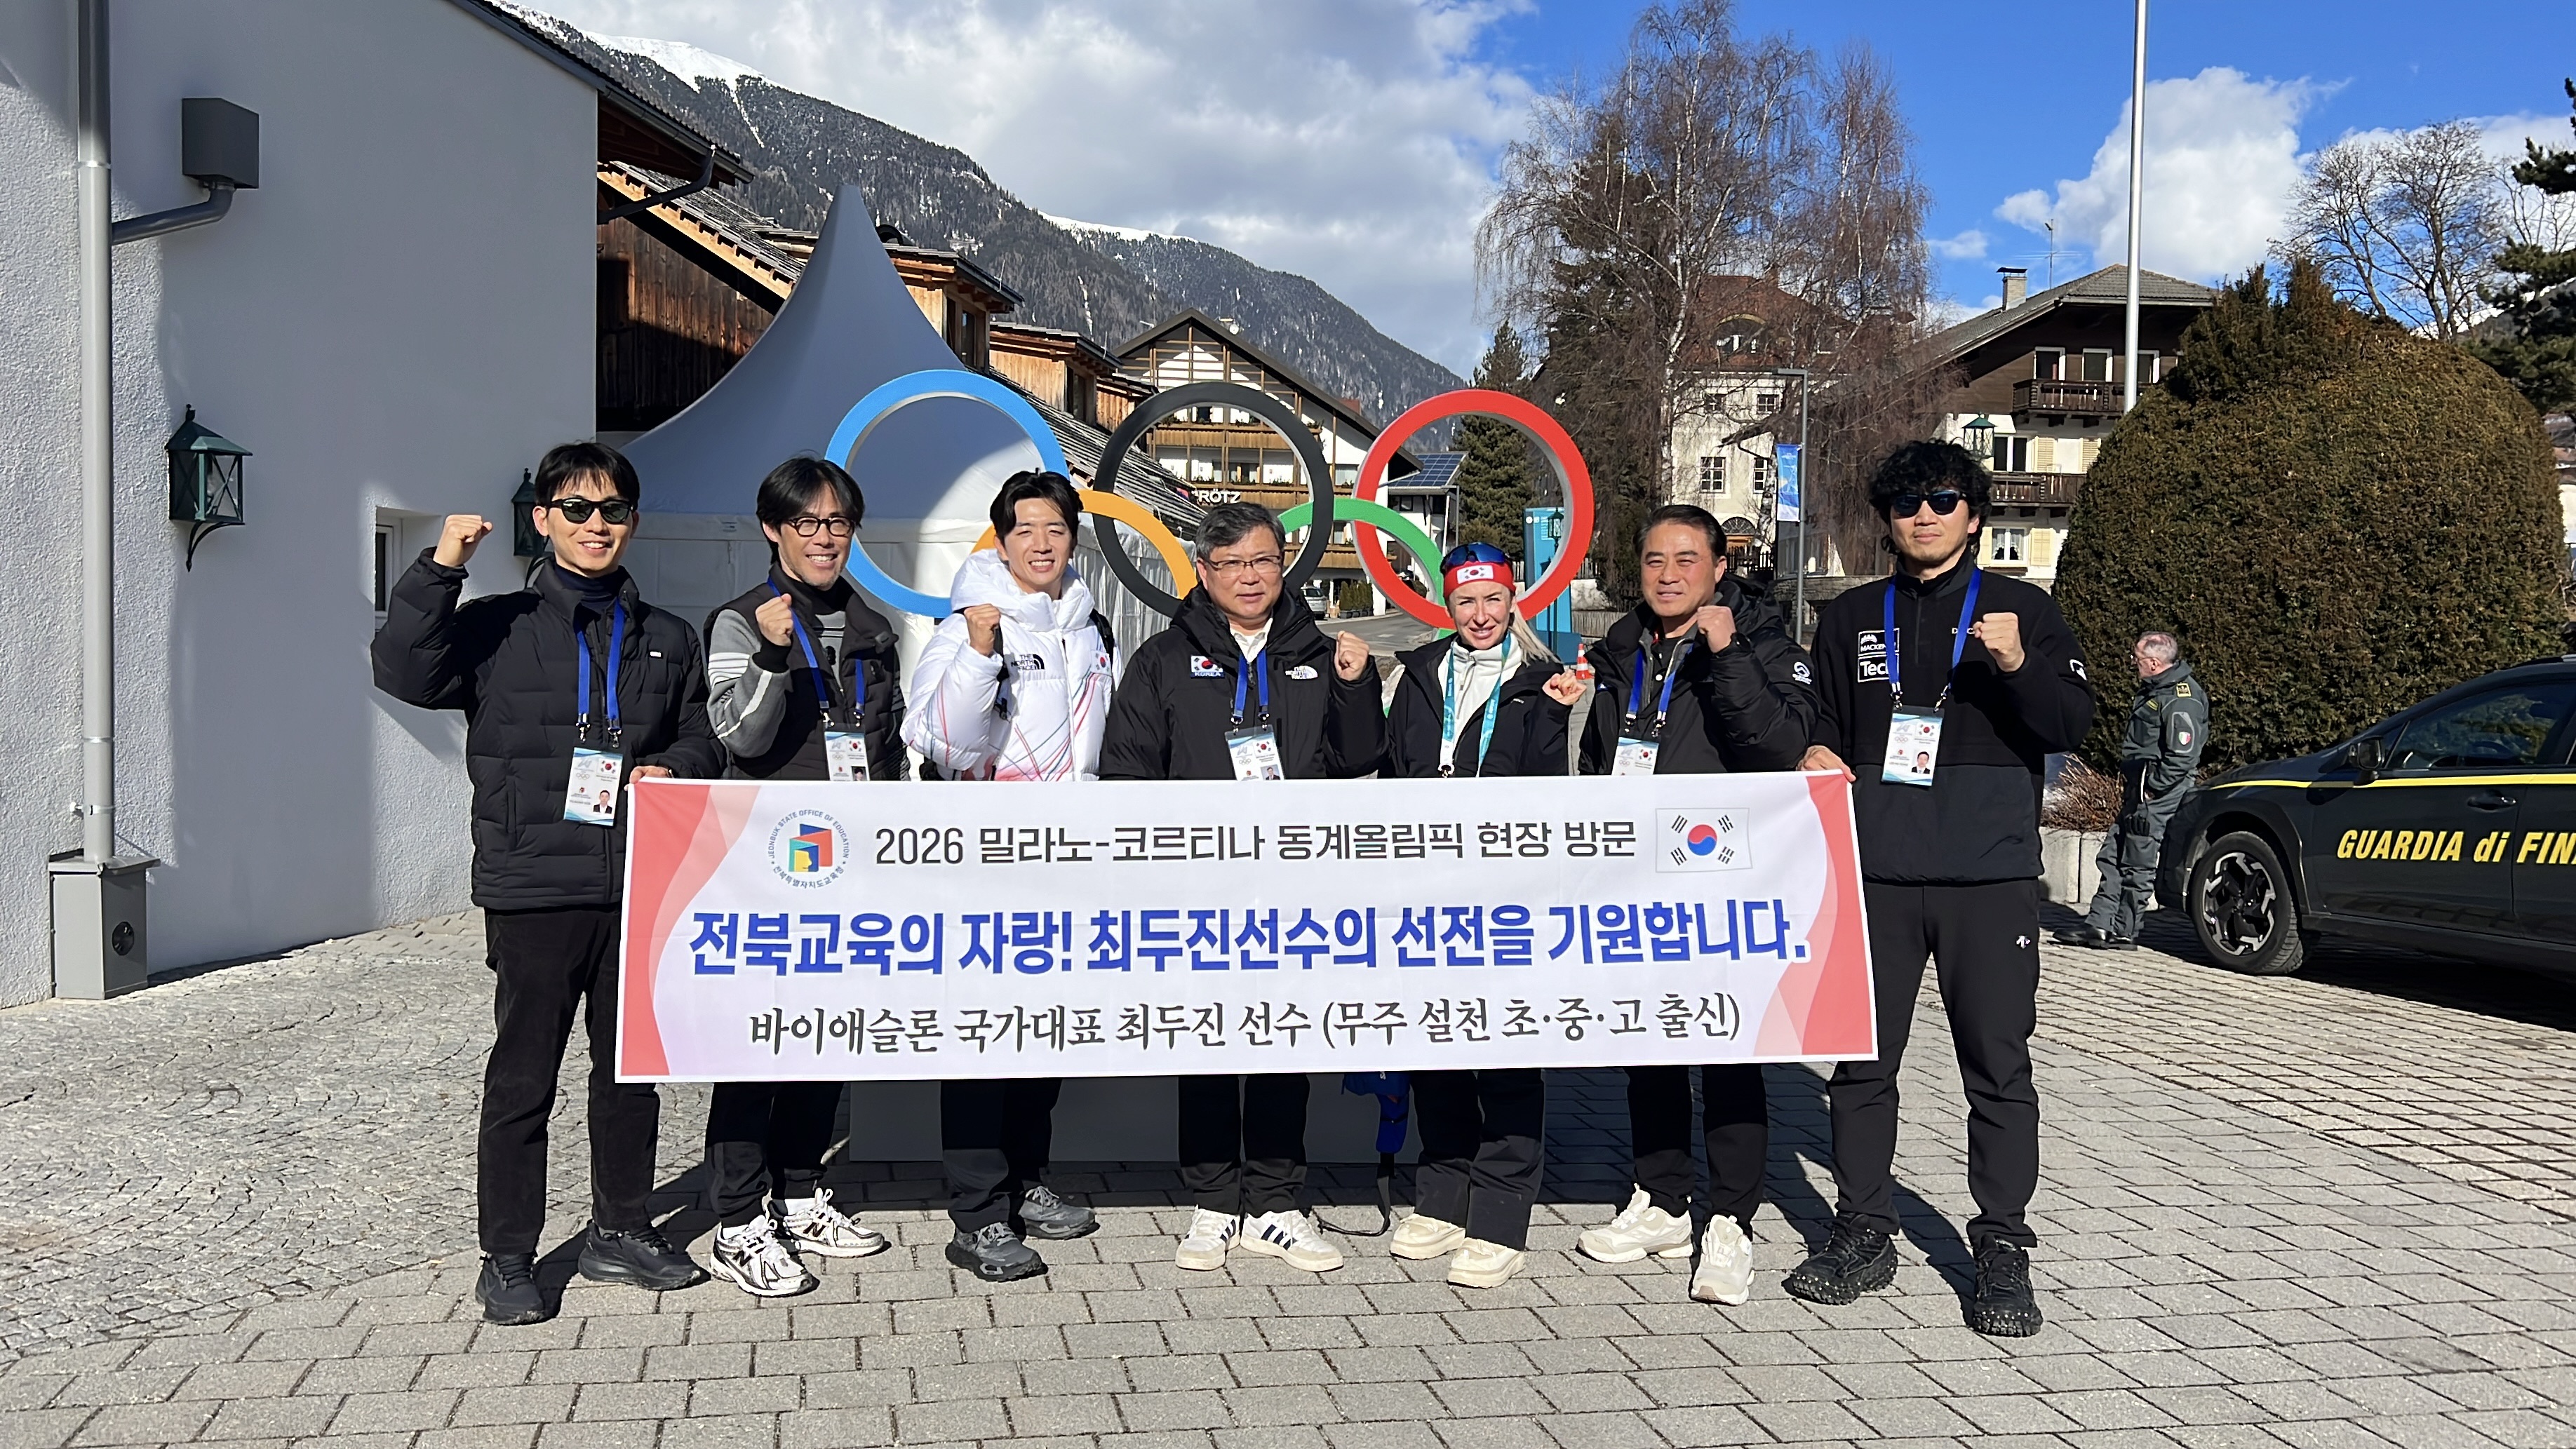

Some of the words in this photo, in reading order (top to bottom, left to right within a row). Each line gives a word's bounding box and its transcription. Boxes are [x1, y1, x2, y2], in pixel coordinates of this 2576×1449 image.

[778, 811, 798, 828] STATE
[798, 809, 824, 818] OFFICE
[824, 814, 834, 822] OF
[833, 821, 850, 858] EDUCATION
[876, 828, 963, 864] 2026
[980, 825, 1266, 864] 밀라노-코르티나
[1277, 823, 1463, 860] 동계올림픽
[1477, 821, 1551, 858] 현장
[1564, 821, 1636, 857] 방문
[2337, 830, 2464, 862] GUARDIA
[2473, 831, 2511, 863] di
[2516, 832, 2576, 865] FIN
[689, 912, 944, 976] 전북교육의
[958, 911, 1072, 974] 자랑!
[1087, 907, 1376, 972] 최두진선수의
[1391, 905, 1534, 968] 선전을
[1548, 899, 1806, 964] 기원합니다.
[749, 1007, 944, 1056] 바이애슬론
[954, 1004, 1106, 1053] 국가대표
[1115, 1002, 1226, 1051] 최두진
[1237, 1002, 1312, 1048] 선수
[1322, 1002, 1407, 1049] (무주
[1418, 997, 1491, 1043] 설천
[1655, 992, 1740, 1041] 출신)
